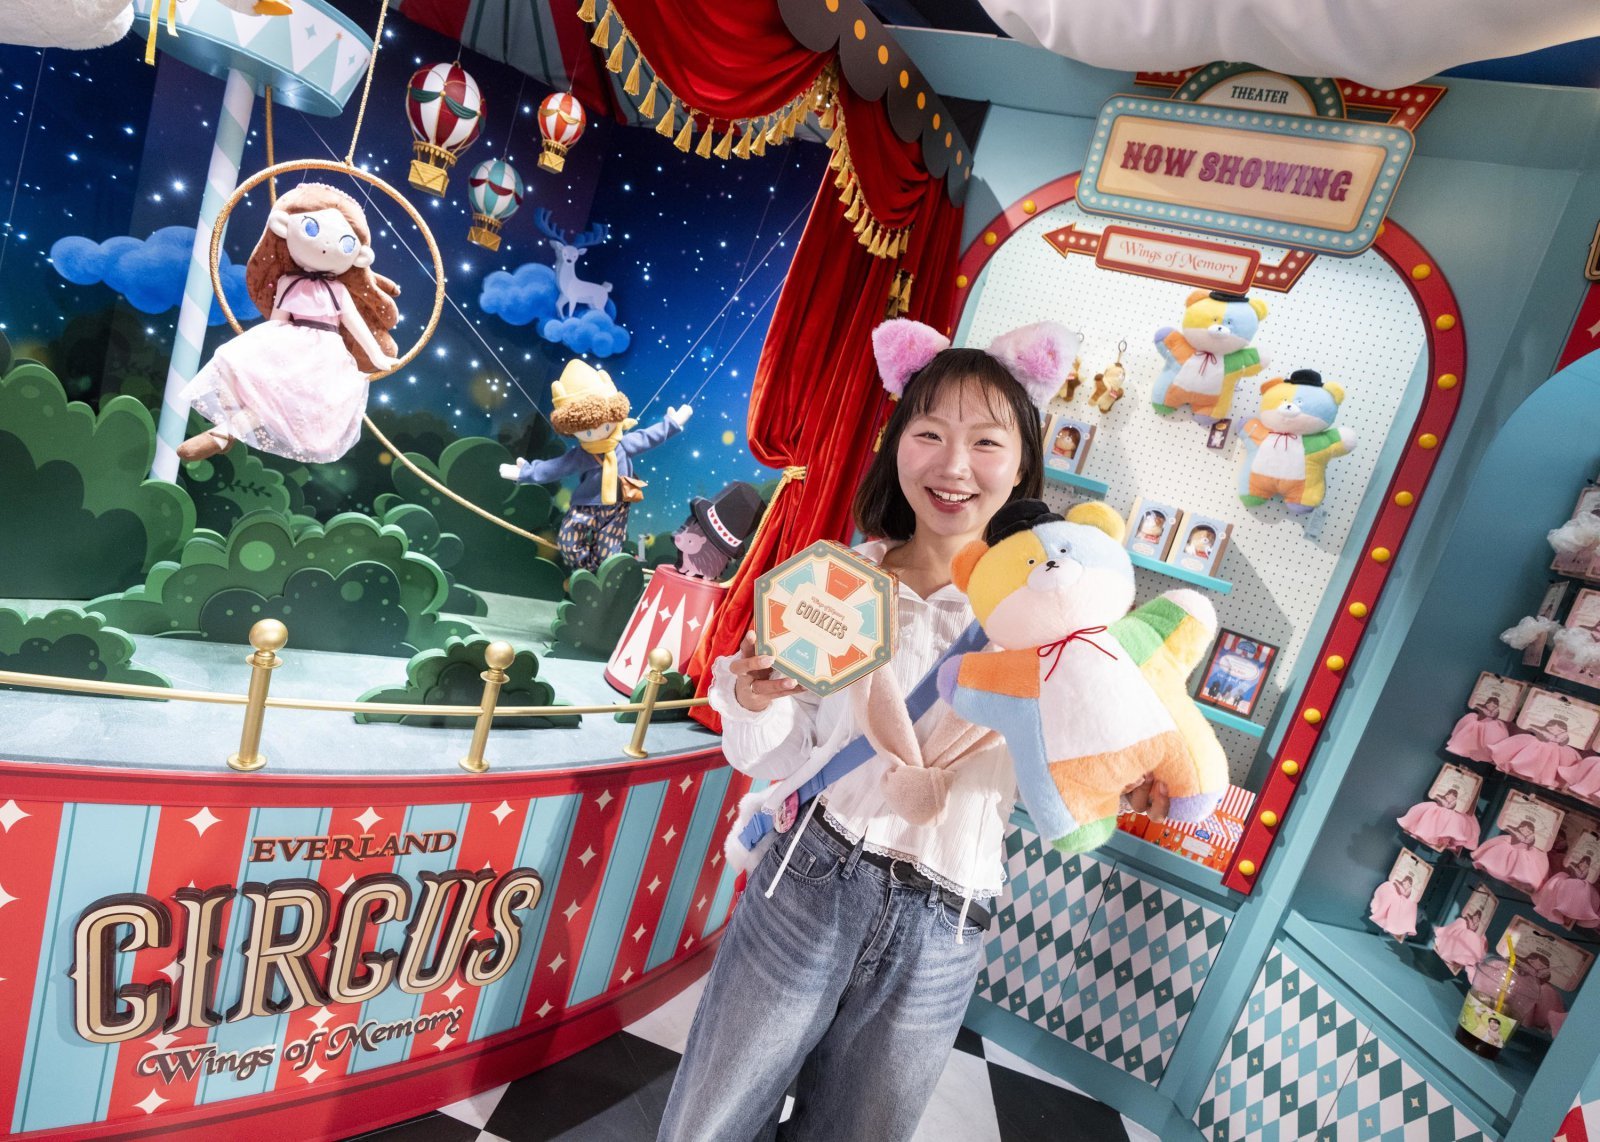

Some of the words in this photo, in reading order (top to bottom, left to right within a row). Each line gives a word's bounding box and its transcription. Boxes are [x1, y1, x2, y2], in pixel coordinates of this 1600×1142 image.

[1231, 86, 1289, 104] THEATER
[1120, 140, 1198, 178] NOW
[1198, 151, 1353, 202] SHOWING
[1119, 239, 1162, 263] Wings
[1164, 250, 1180, 267] of
[1178, 252, 1239, 280] Memory
[796, 600, 848, 639] COOKIES
[249, 831, 457, 863] EVERLAND
[68, 866, 545, 1044] CIRCUS
[136, 1043, 275, 1085] Wings
[284, 1032, 326, 1069] of
[326, 1004, 466, 1059] Memory
